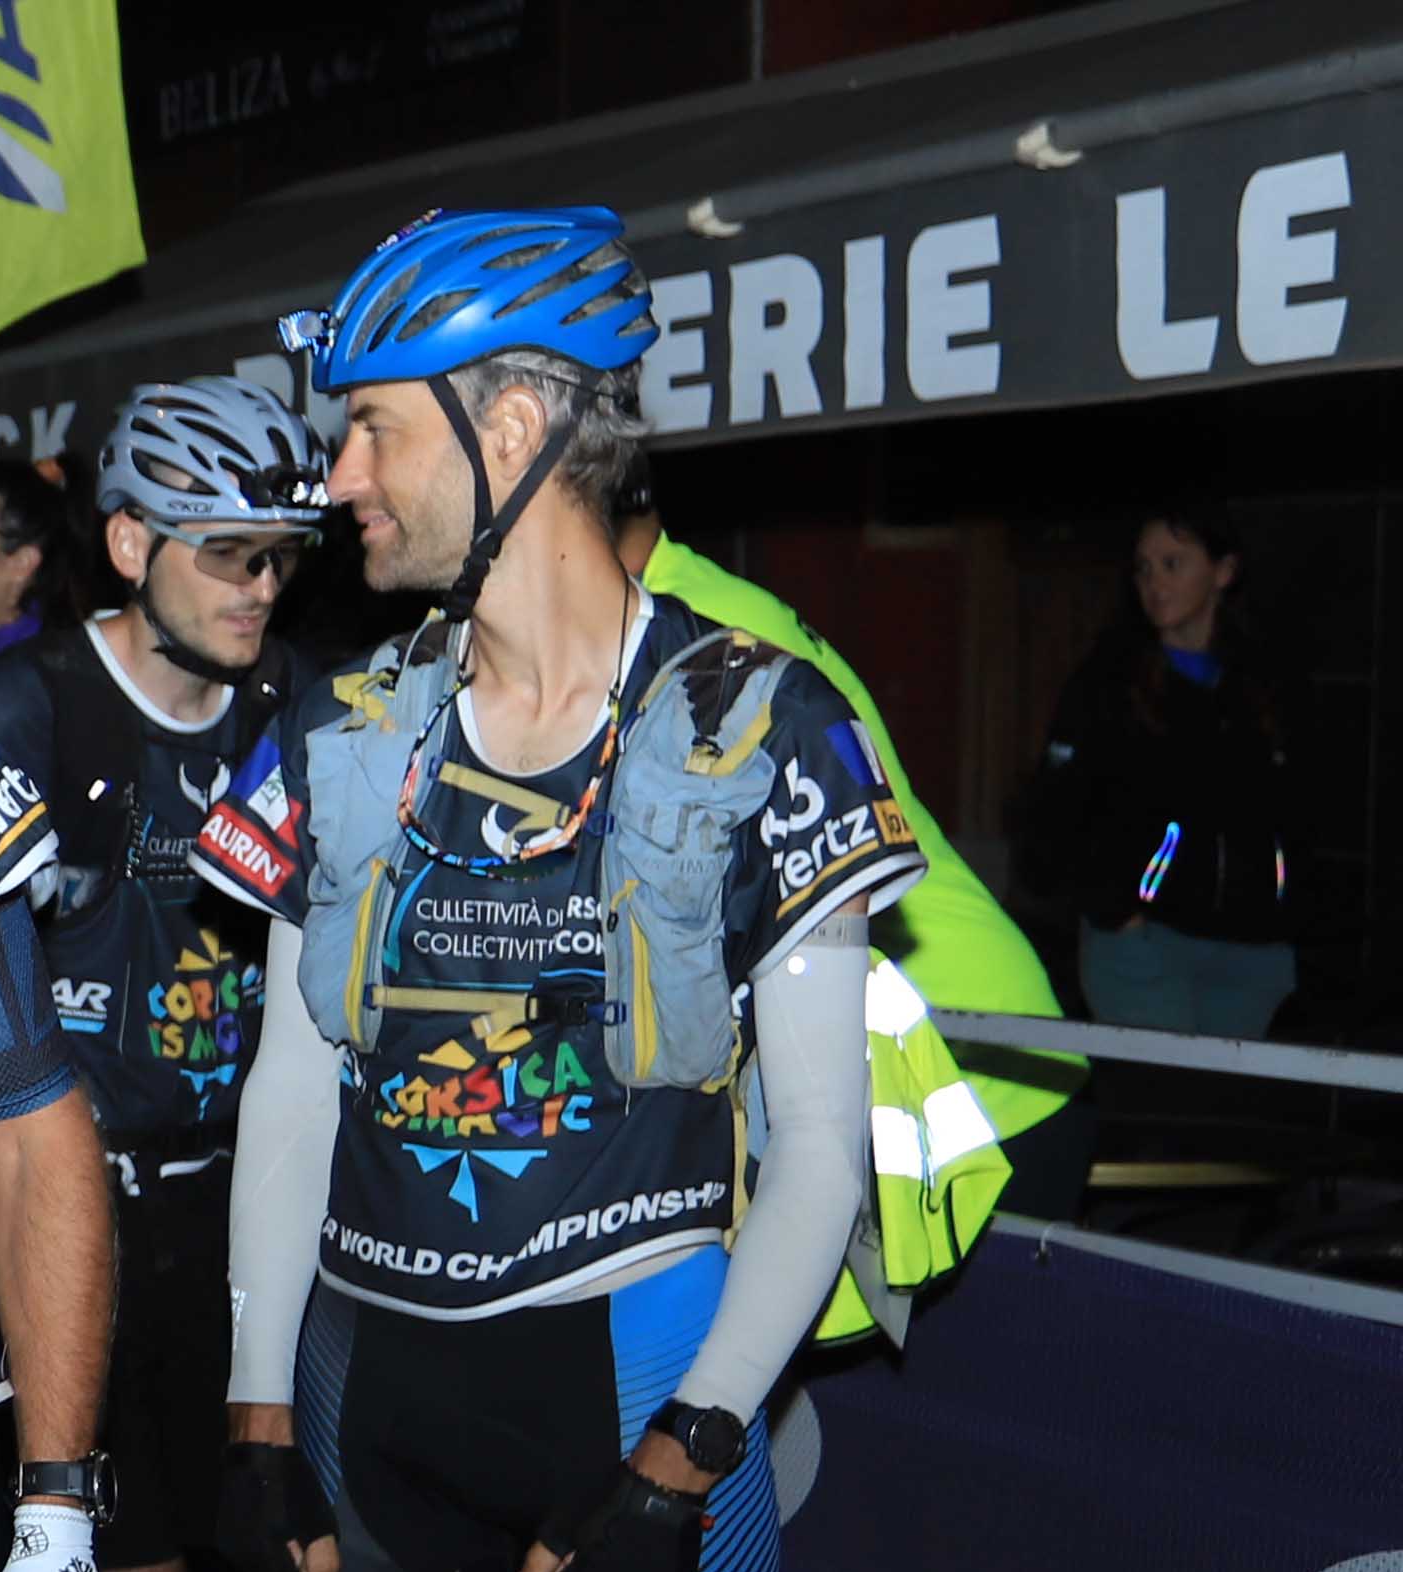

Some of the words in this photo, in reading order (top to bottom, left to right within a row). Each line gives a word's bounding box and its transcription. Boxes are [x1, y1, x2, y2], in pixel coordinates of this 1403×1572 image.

[1115, 152, 1353, 382] LE
[415, 896, 542, 927] CULLETTIVITÀ
[546, 908, 564, 926] DI
[339, 1227, 444, 1282] WORLD
